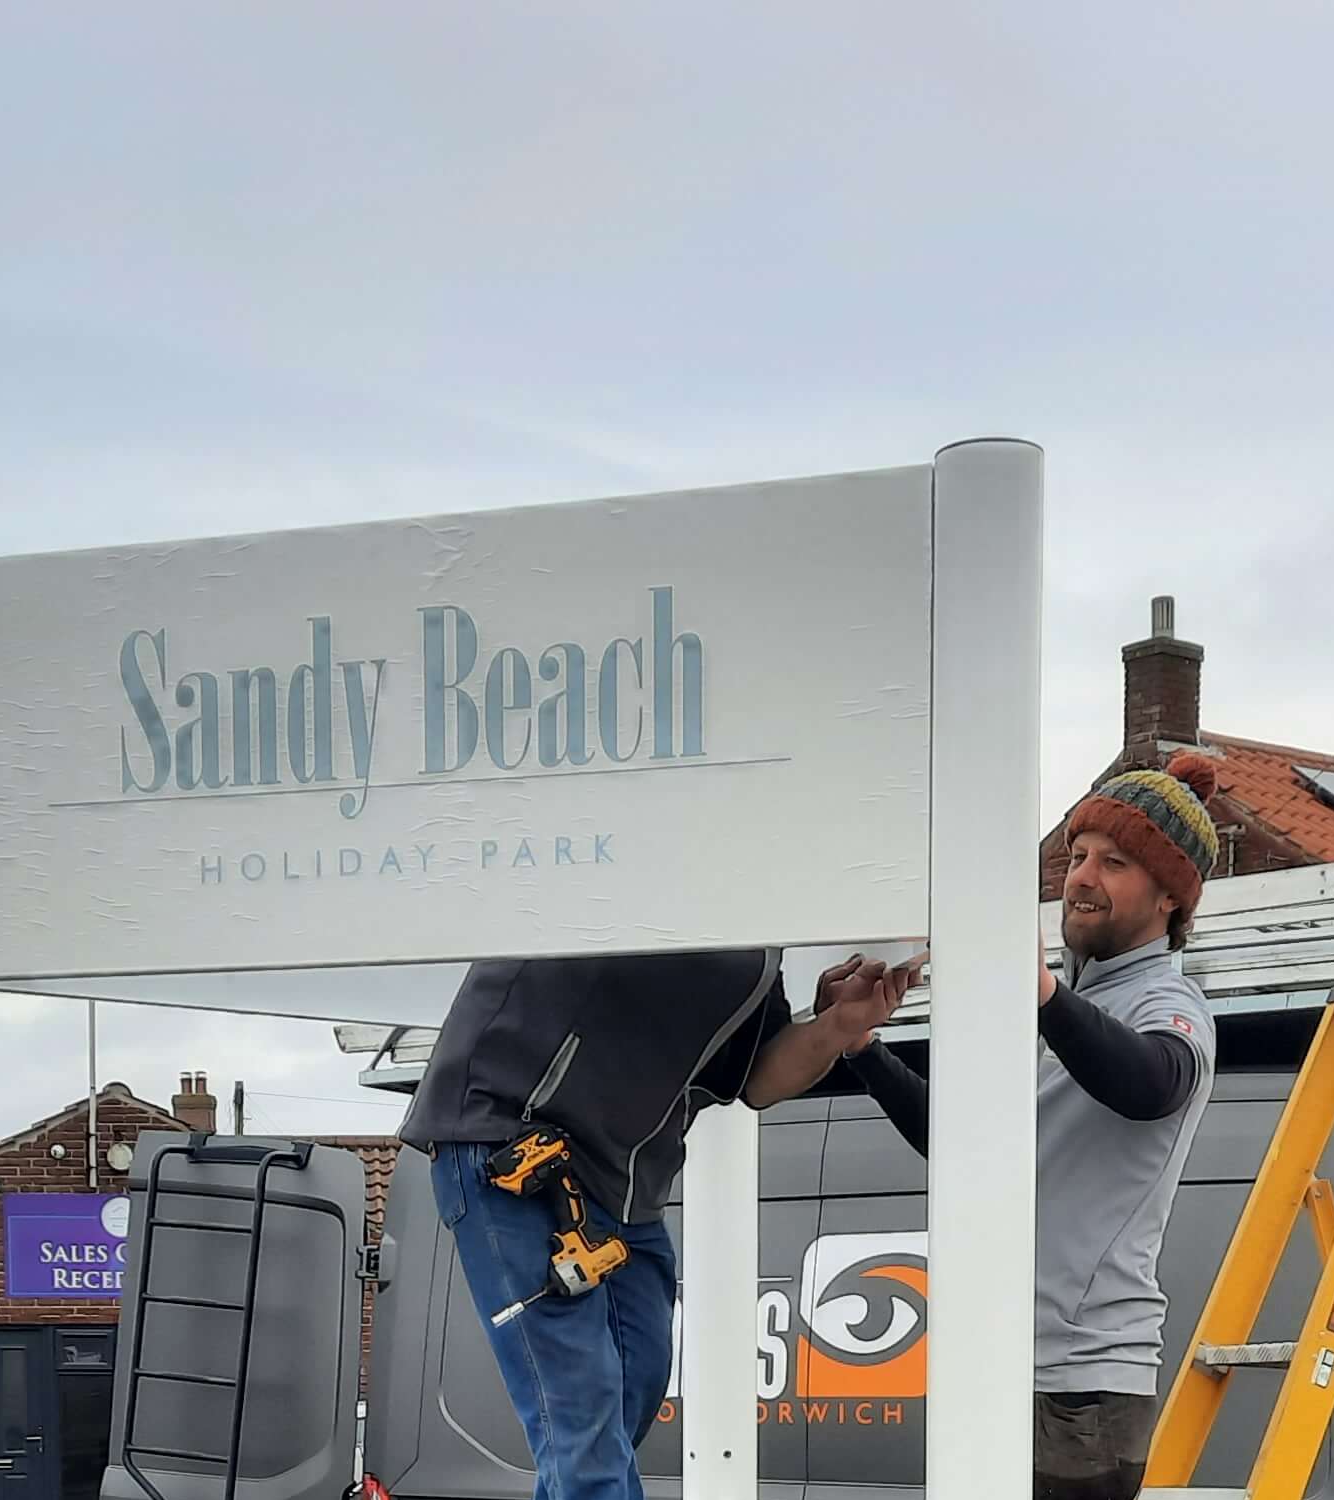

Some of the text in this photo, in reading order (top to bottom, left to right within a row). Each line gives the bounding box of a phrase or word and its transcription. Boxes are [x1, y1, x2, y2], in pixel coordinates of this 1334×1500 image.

[119, 584, 707, 819] Sandy Beach
[199, 832, 615, 886] HOLIDAY PARK
[39, 1241, 108, 1263] SALES
